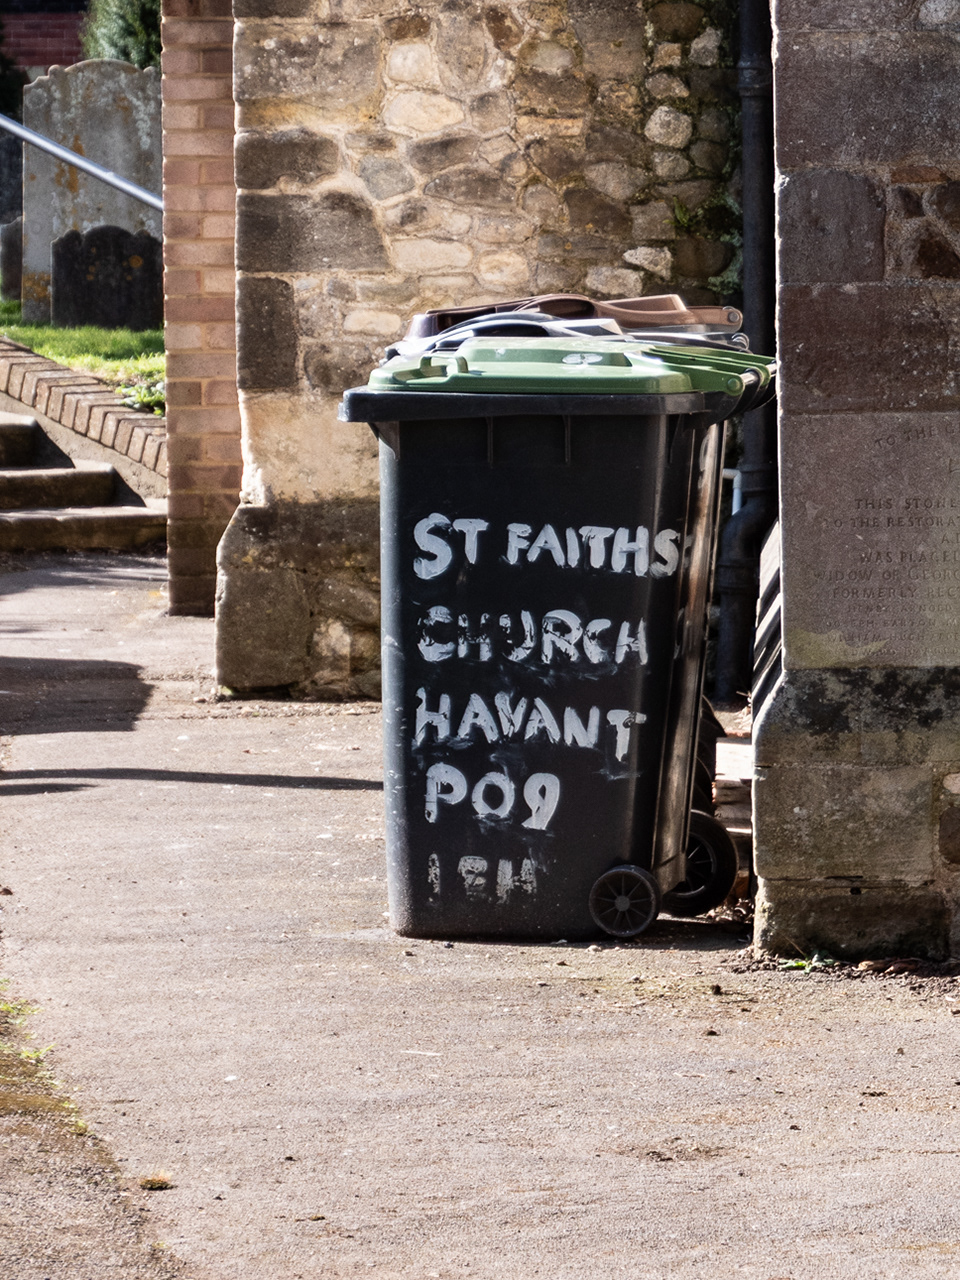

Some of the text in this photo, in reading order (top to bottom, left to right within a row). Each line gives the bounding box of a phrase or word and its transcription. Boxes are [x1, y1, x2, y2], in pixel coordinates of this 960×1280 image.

[873, 434, 896, 449] TO
[903, 425, 938, 443] THE
[854, 498, 893, 510] THIS
[904, 497, 957, 510] STONE
[850, 516, 880, 528] THE
[413, 512, 490, 580] ST
[502, 523, 682, 578] FAITHS
[859, 550, 893, 564] WAS
[882, 569, 899, 582] OF
[833, 586, 917, 599] FORMERLY
[416, 605, 650, 666] CHURCH
[413, 687, 647, 763] HAVANT
